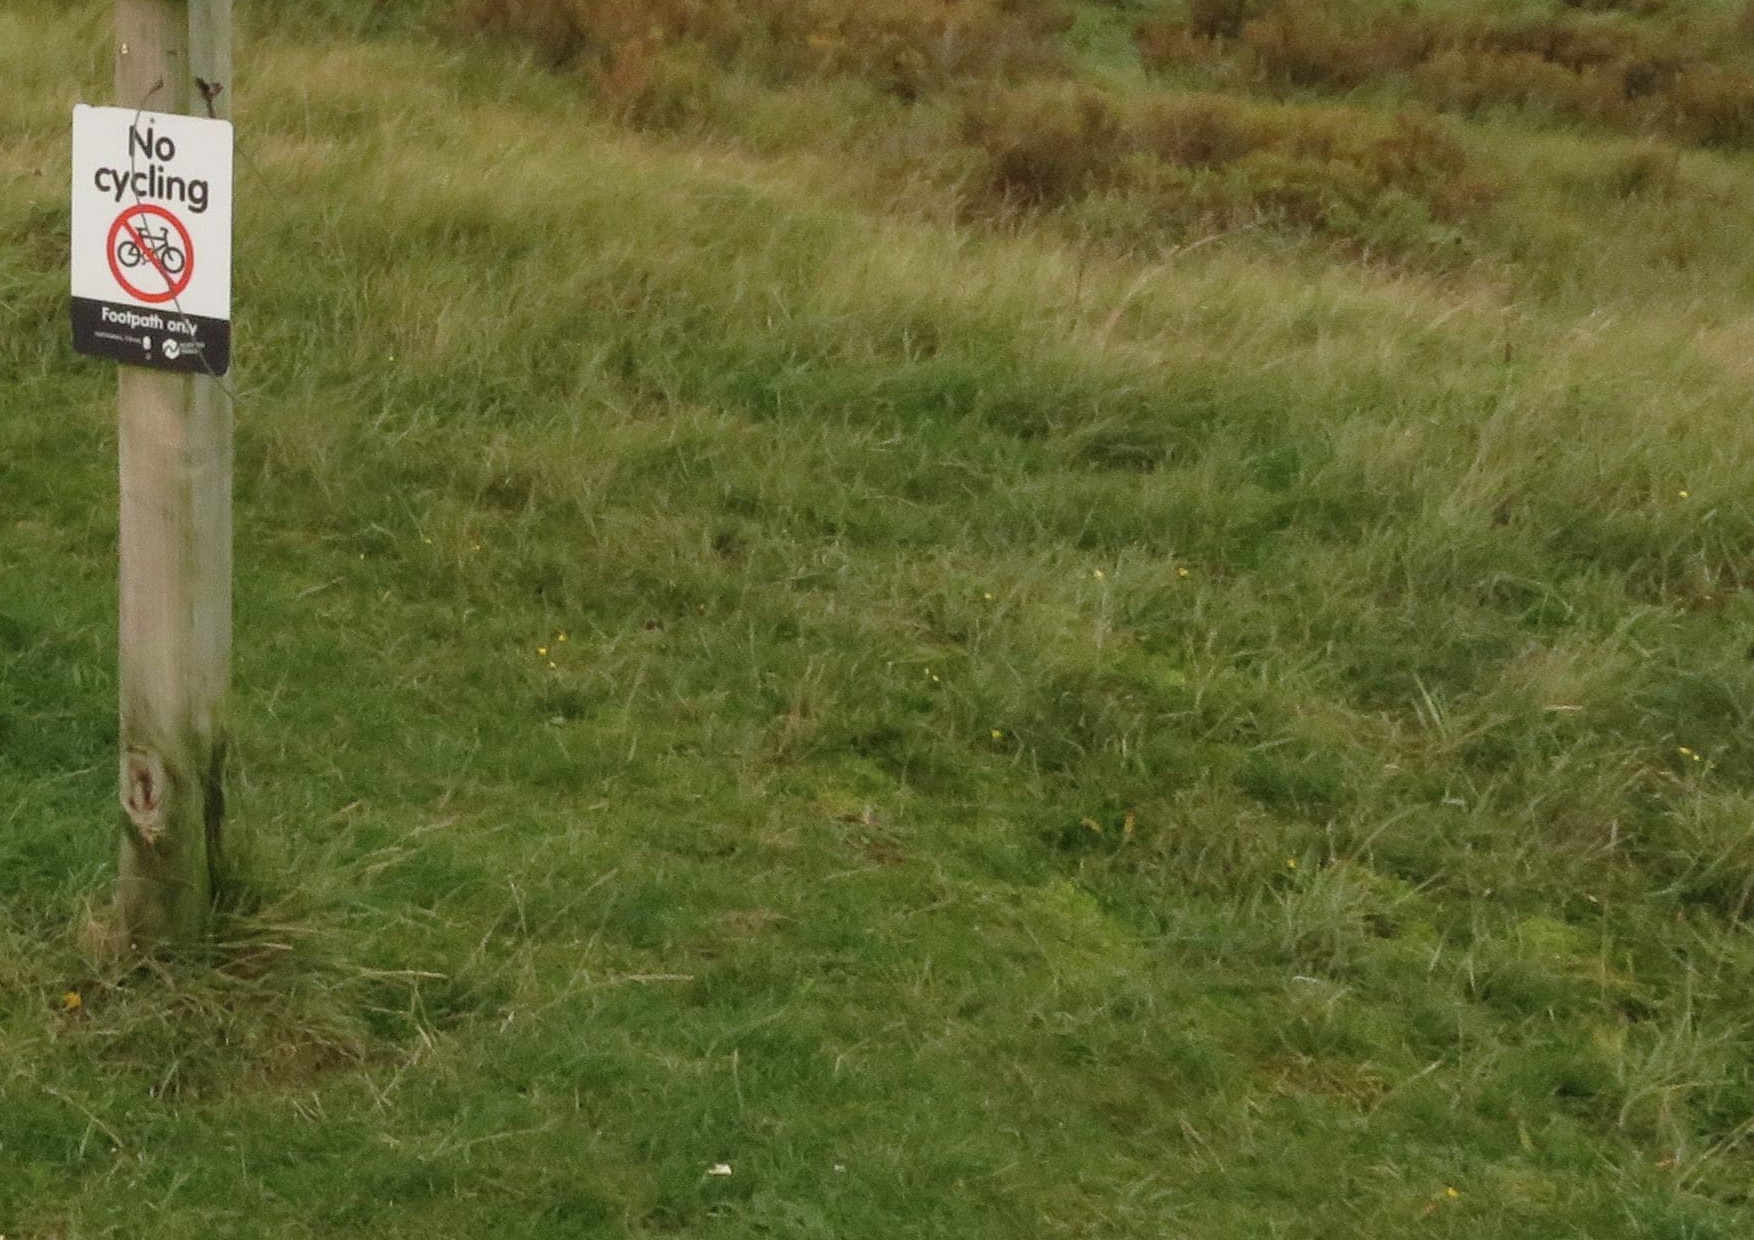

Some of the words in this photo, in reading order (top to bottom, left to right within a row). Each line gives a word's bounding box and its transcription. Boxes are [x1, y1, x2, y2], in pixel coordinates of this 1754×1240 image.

[129, 124, 176, 161] No
[94, 164, 209, 214] cycling
[101, 306, 164, 329] Footpath
[167, 318, 198, 337] only
